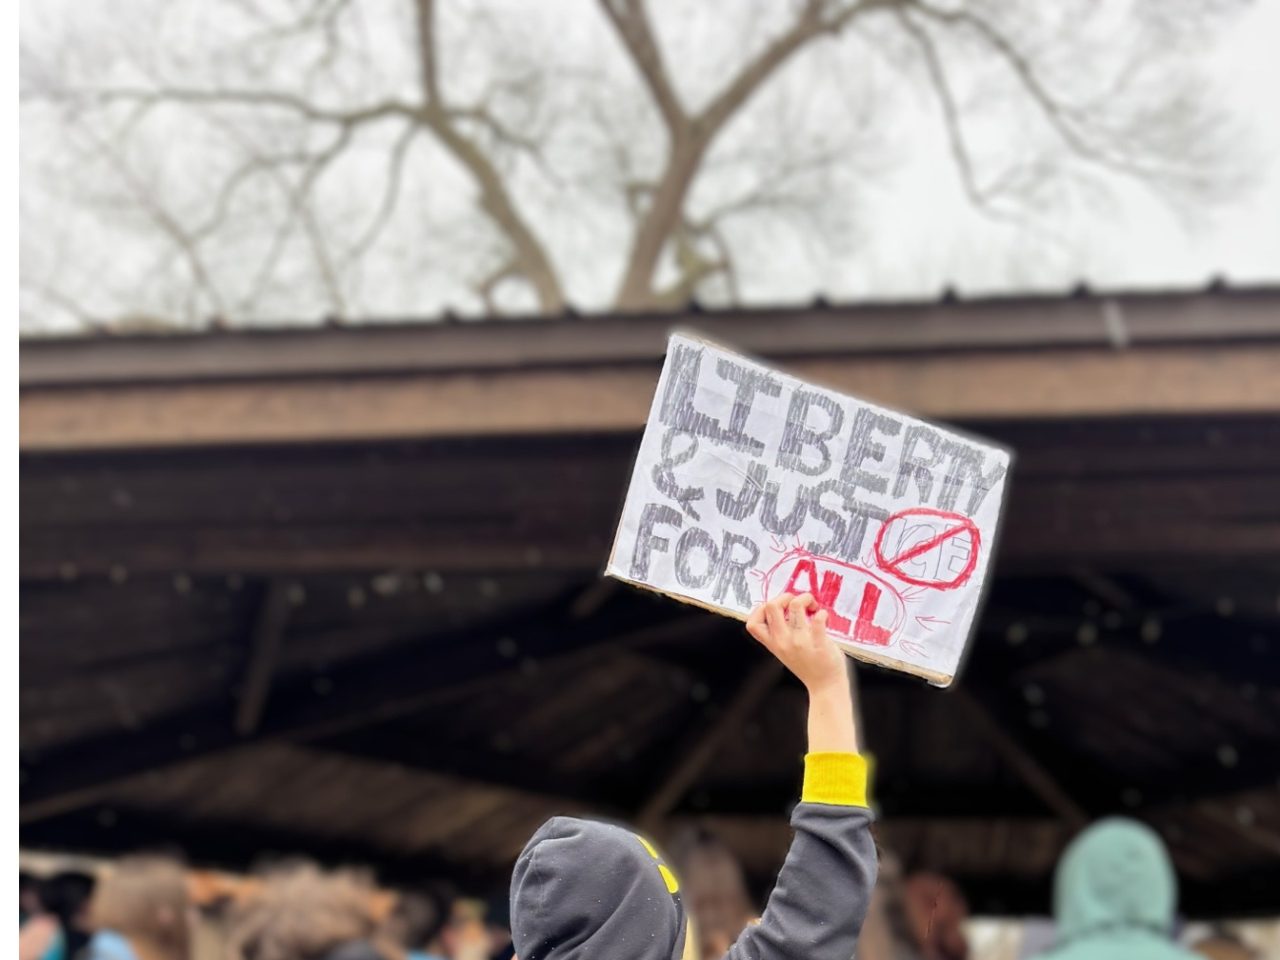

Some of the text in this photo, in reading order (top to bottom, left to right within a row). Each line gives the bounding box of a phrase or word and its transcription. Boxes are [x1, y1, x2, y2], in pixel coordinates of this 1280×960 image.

[659, 344, 1006, 516] LIBERTY
[629, 503, 760, 608] FOR
[783, 559, 891, 646] ALL
